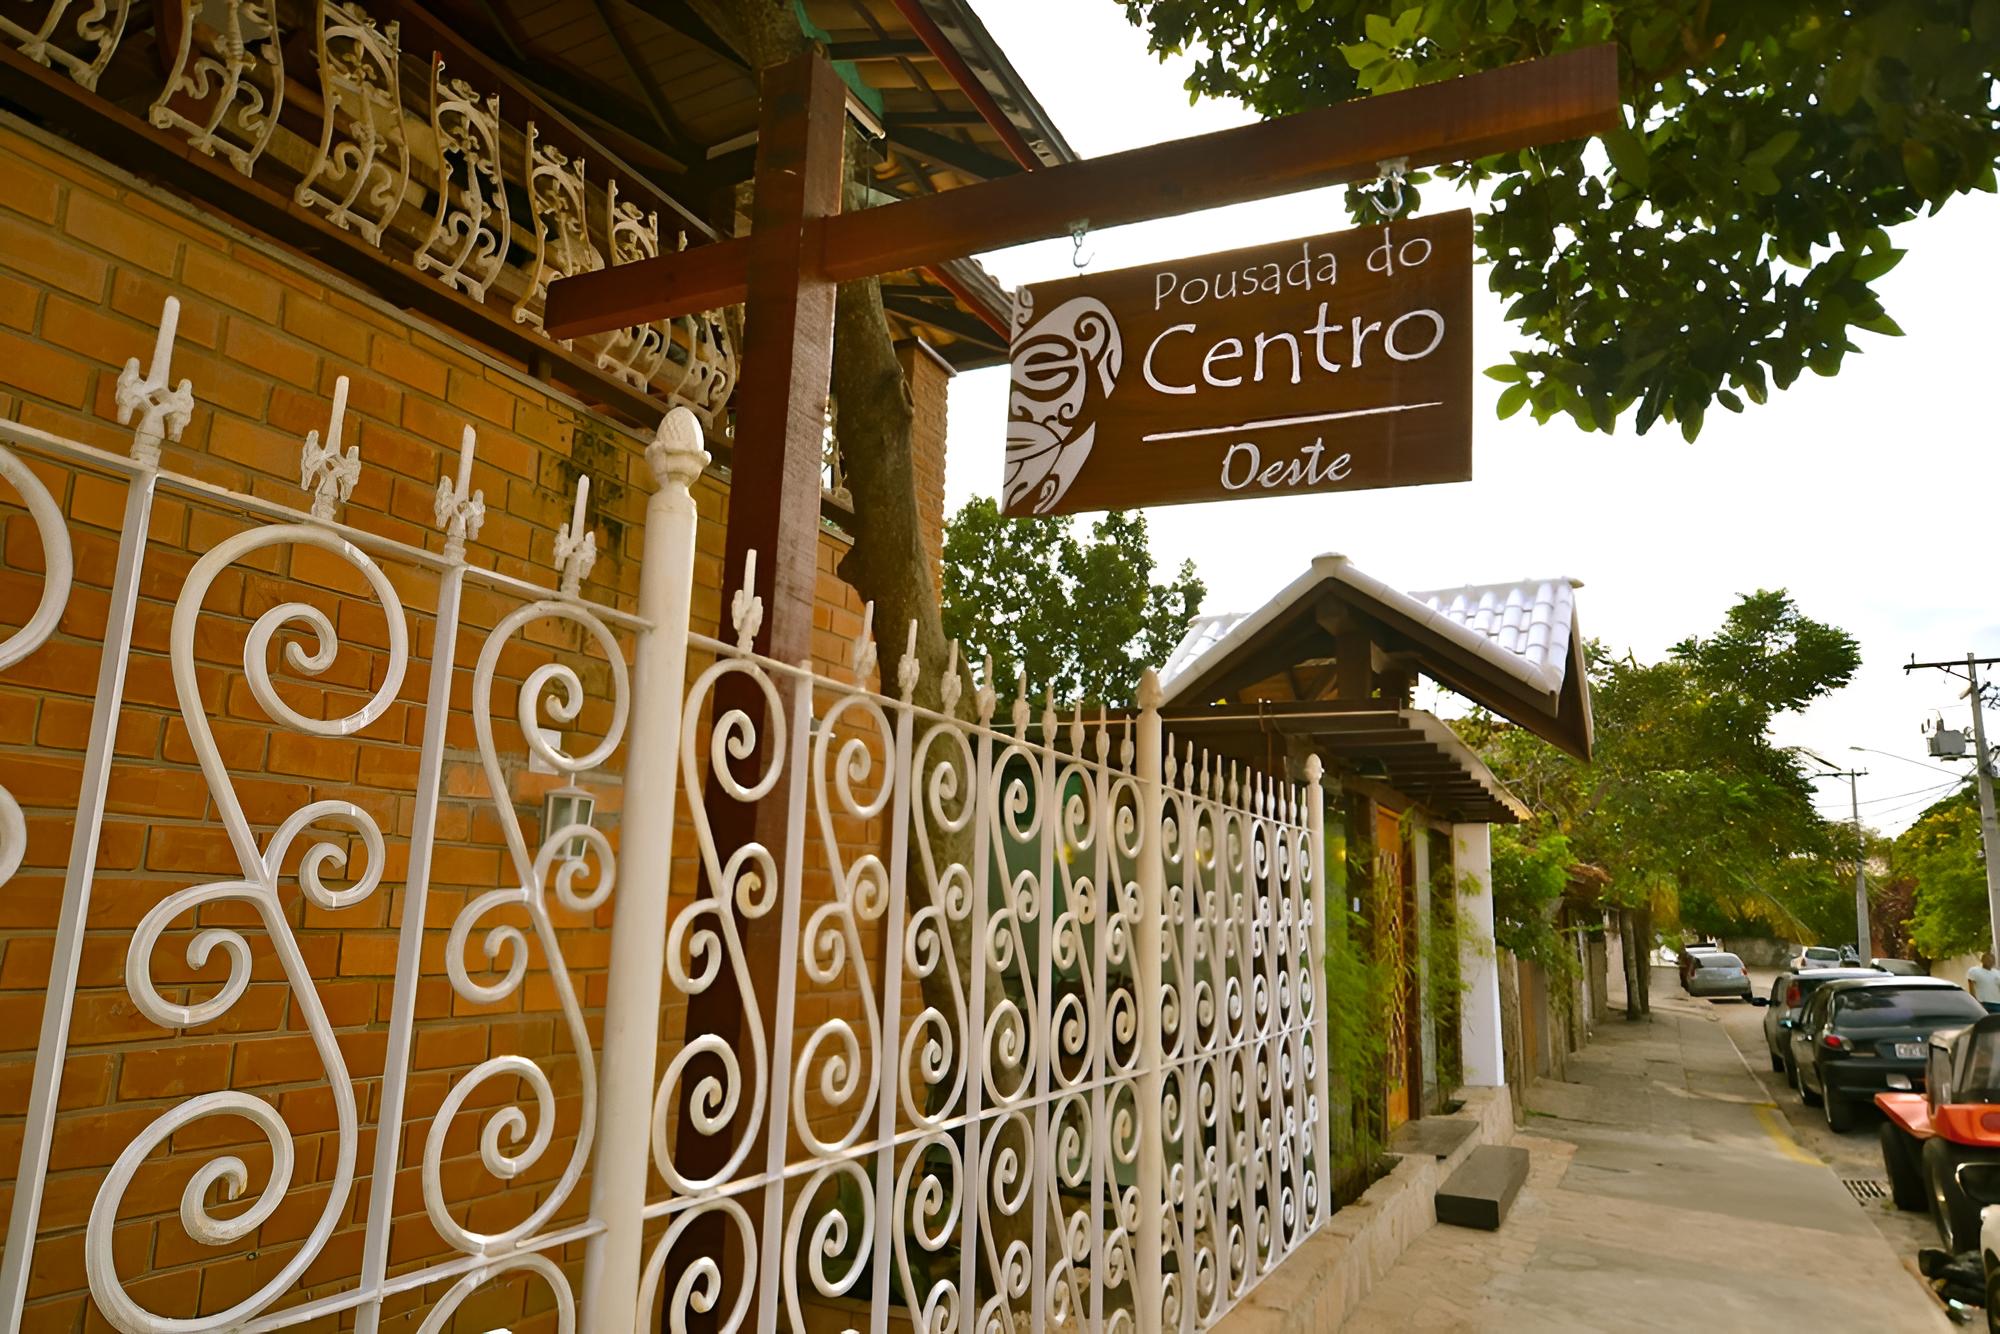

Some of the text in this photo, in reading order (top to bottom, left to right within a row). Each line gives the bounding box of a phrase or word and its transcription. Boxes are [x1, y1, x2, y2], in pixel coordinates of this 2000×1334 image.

[1154, 227, 1432, 310] Pousada do
[1142, 302, 1445, 395] Centro
[1220, 437, 1352, 490] Oeste
